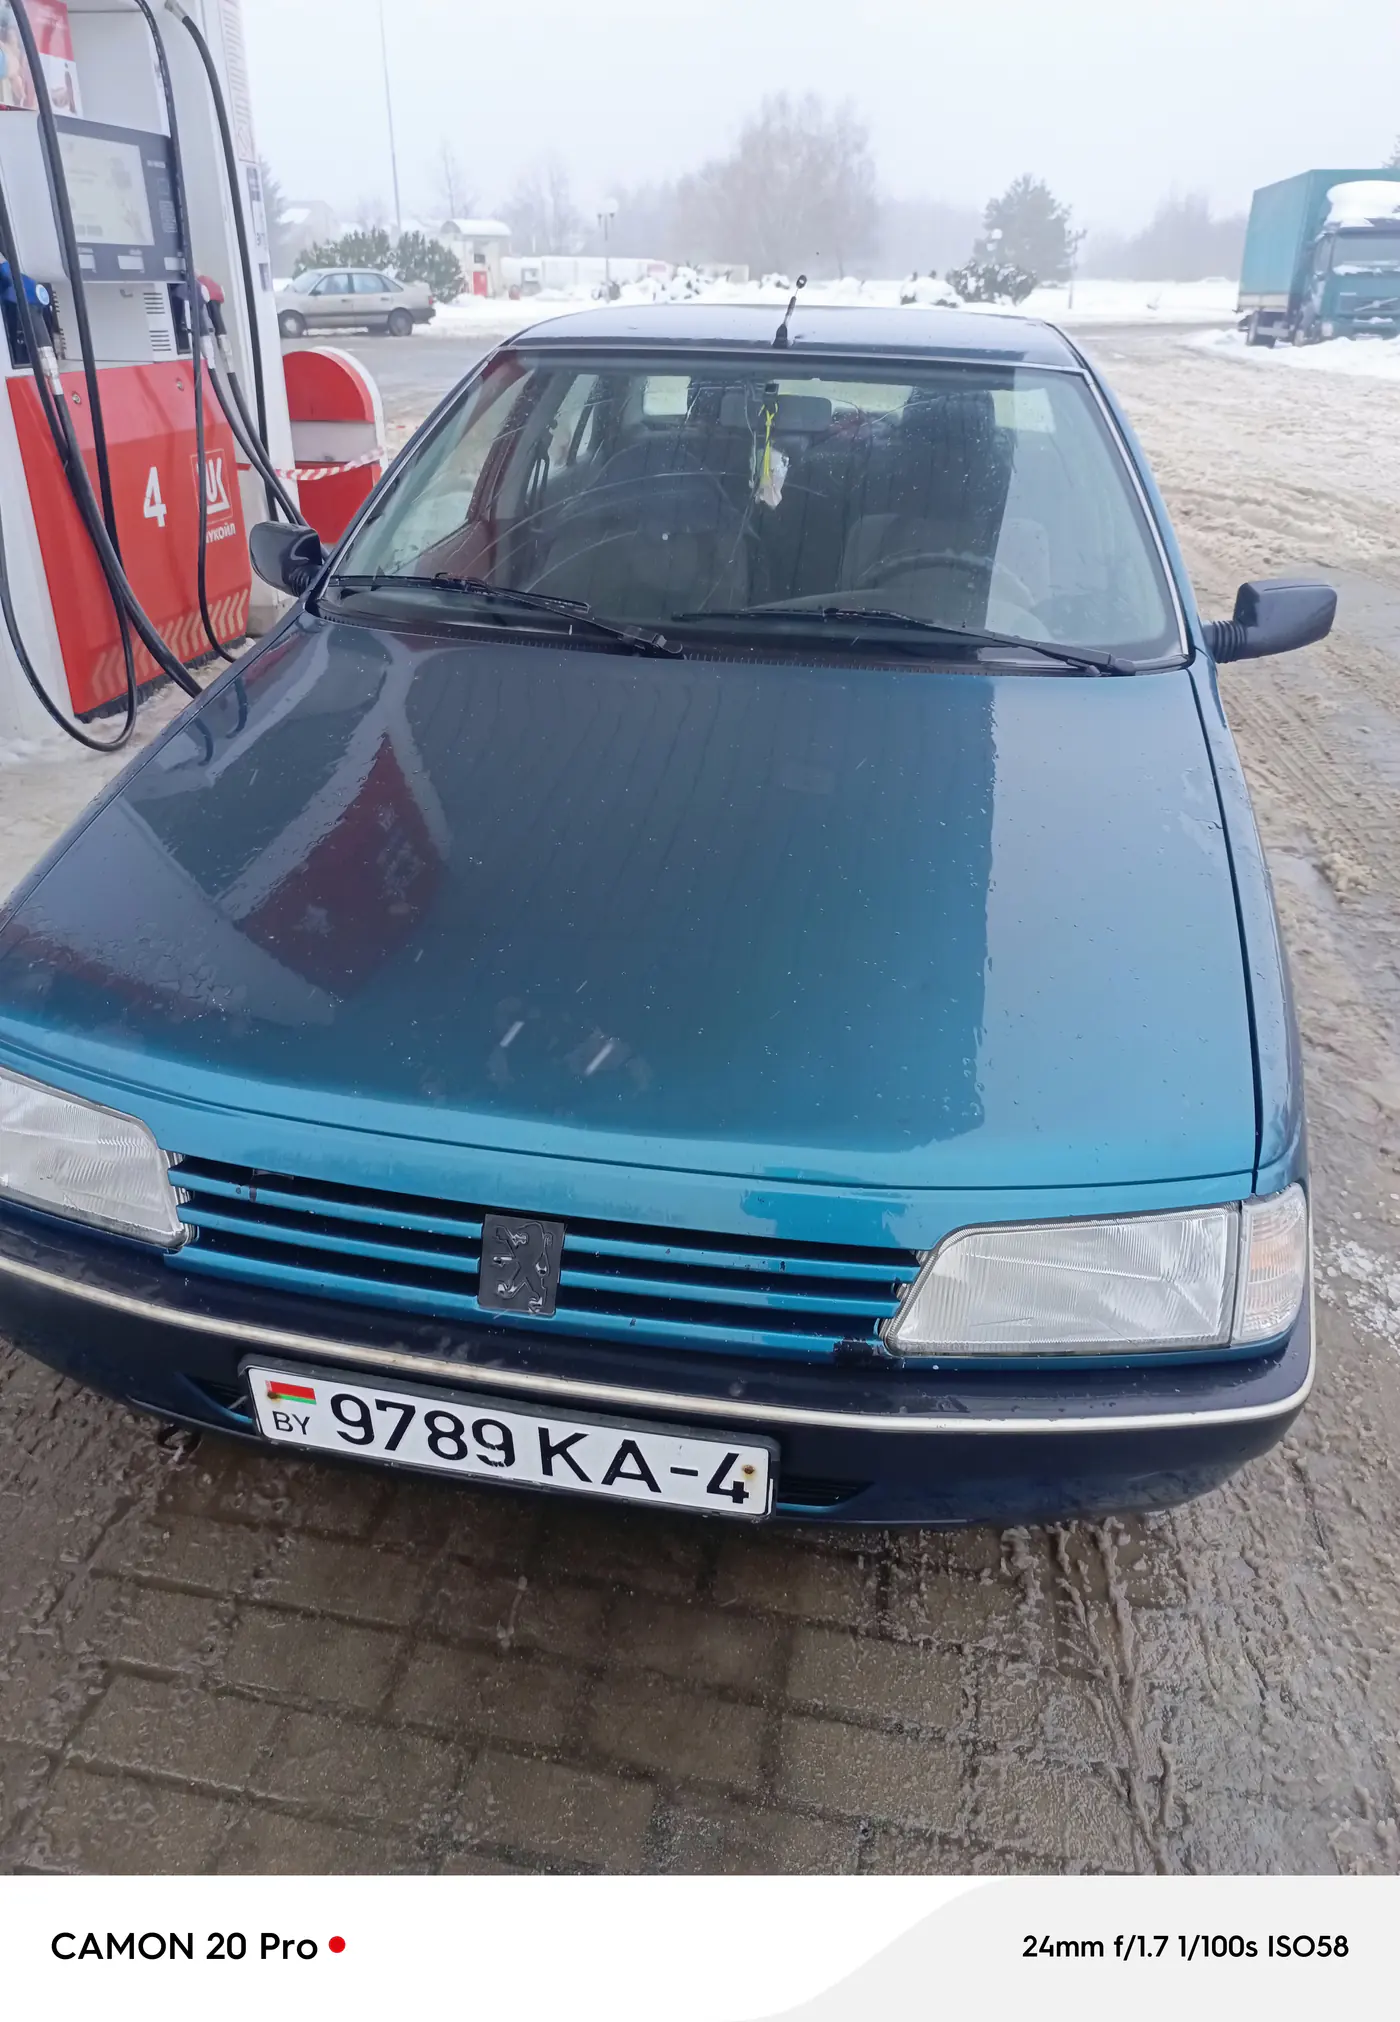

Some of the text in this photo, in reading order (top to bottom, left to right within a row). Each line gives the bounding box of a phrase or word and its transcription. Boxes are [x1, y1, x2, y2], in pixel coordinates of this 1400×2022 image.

[143, 466, 167, 528] 4
[272, 1410, 310, 1436] BY
[330, 1393, 516, 1468] 9789
